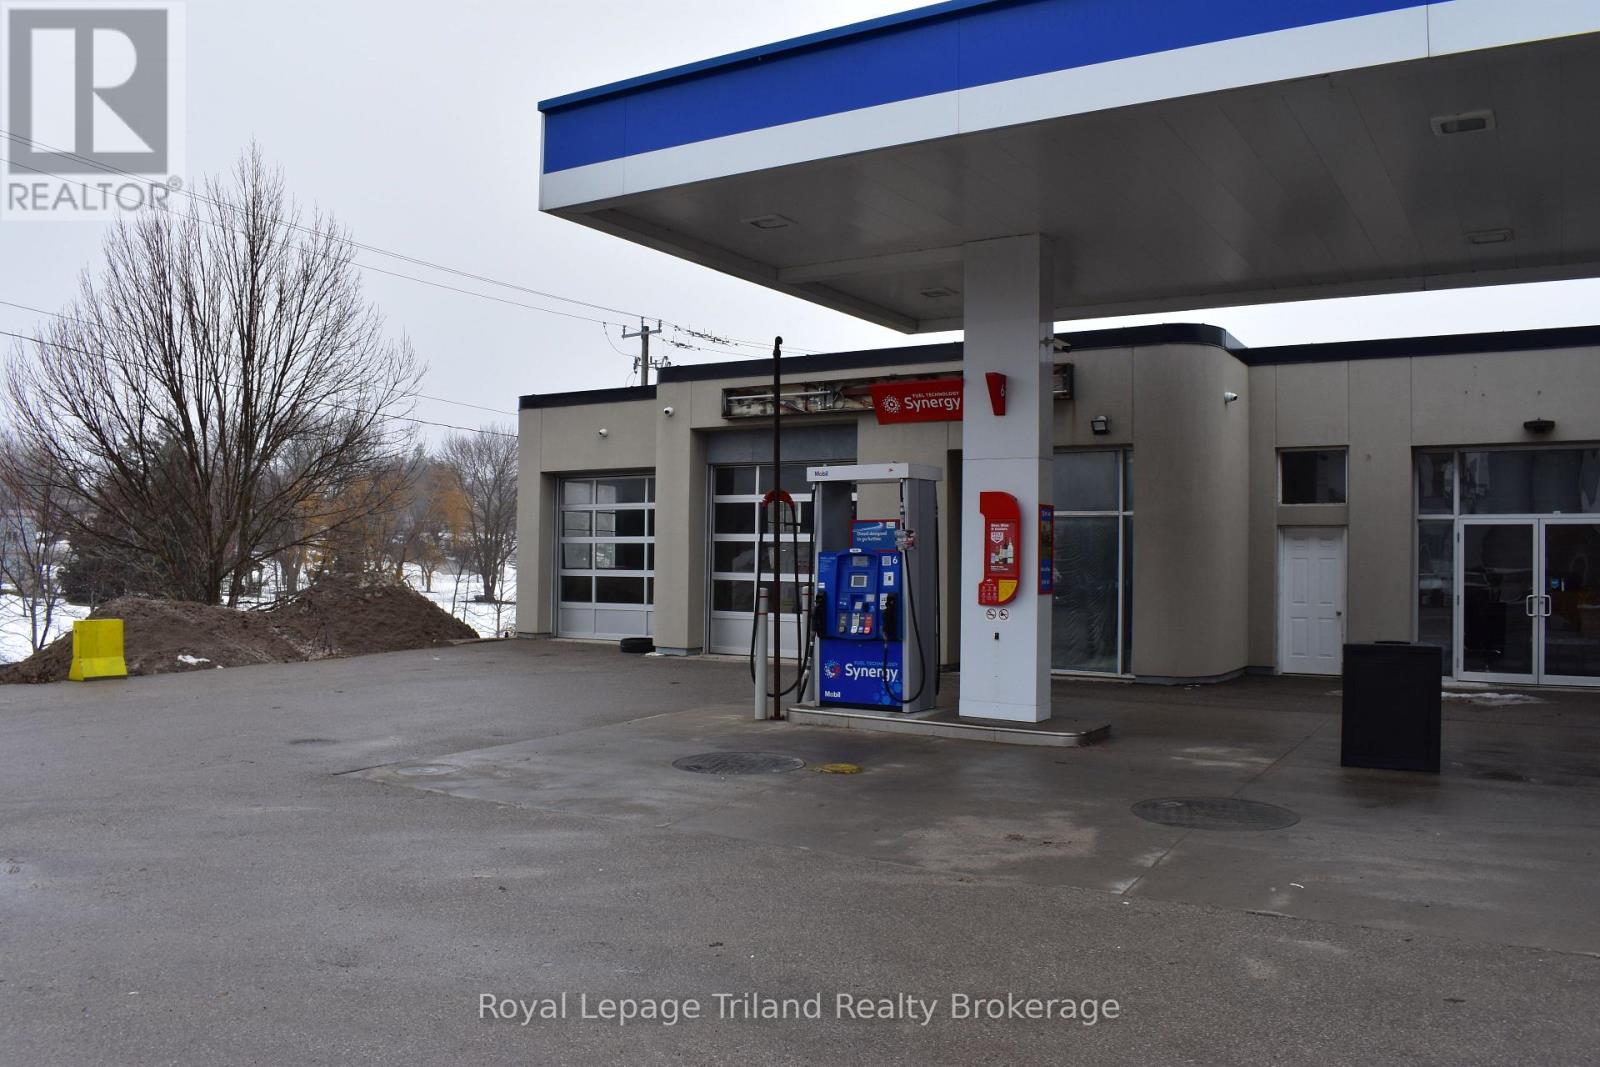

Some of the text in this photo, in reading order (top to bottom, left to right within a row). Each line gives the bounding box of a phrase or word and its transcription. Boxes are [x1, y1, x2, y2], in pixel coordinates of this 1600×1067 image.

[904, 396, 961, 412] Synergy
[892, 556, 898, 565] 6
[824, 690, 841, 698] Mobil
